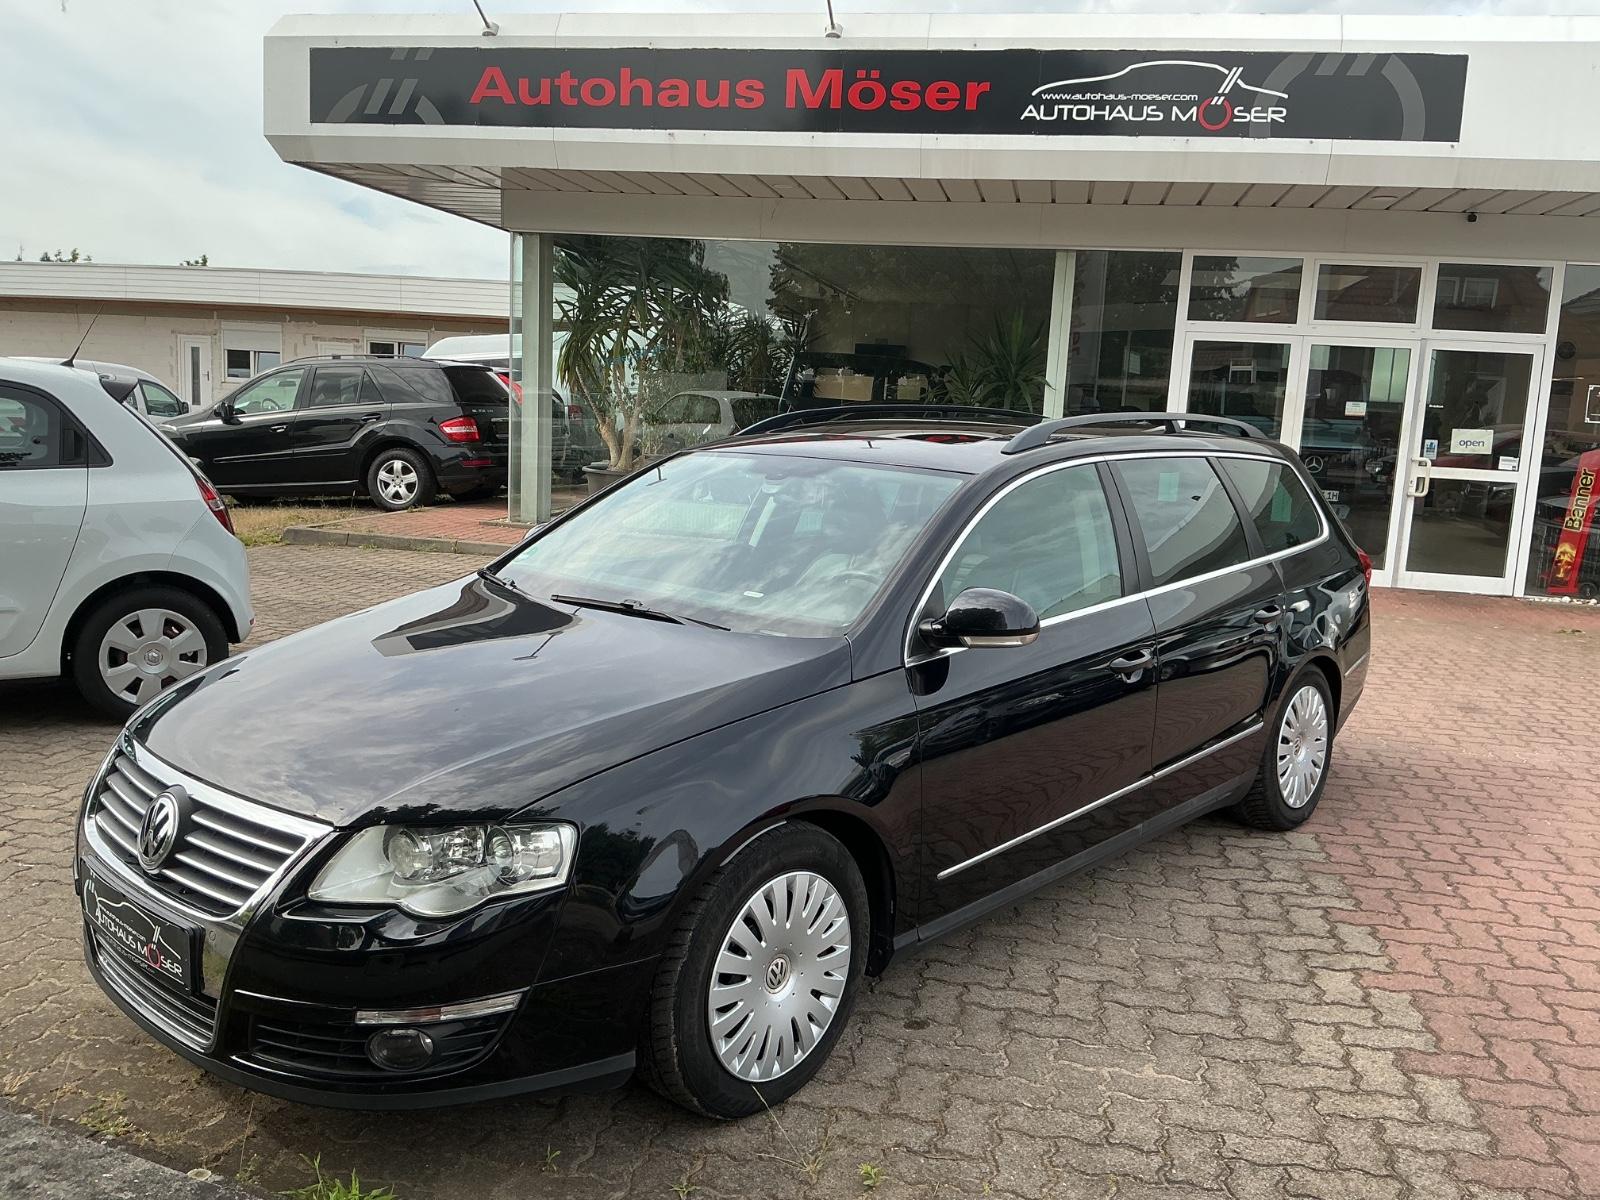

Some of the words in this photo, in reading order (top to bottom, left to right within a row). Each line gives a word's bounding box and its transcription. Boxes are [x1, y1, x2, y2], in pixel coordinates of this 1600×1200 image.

[469, 65, 765, 110] Autohaus
[784, 68, 991, 111] Möser
[1041, 92, 1198, 102] www.autohaus-moeser.com
[1020, 104, 1163, 121] AUTOHAUS
[1171, 96, 1287, 131] MÖSER
[1458, 439, 1485, 449] open
[1564, 468, 1595, 532] Banner
[95, 907, 136, 949] AUTOHAUS
